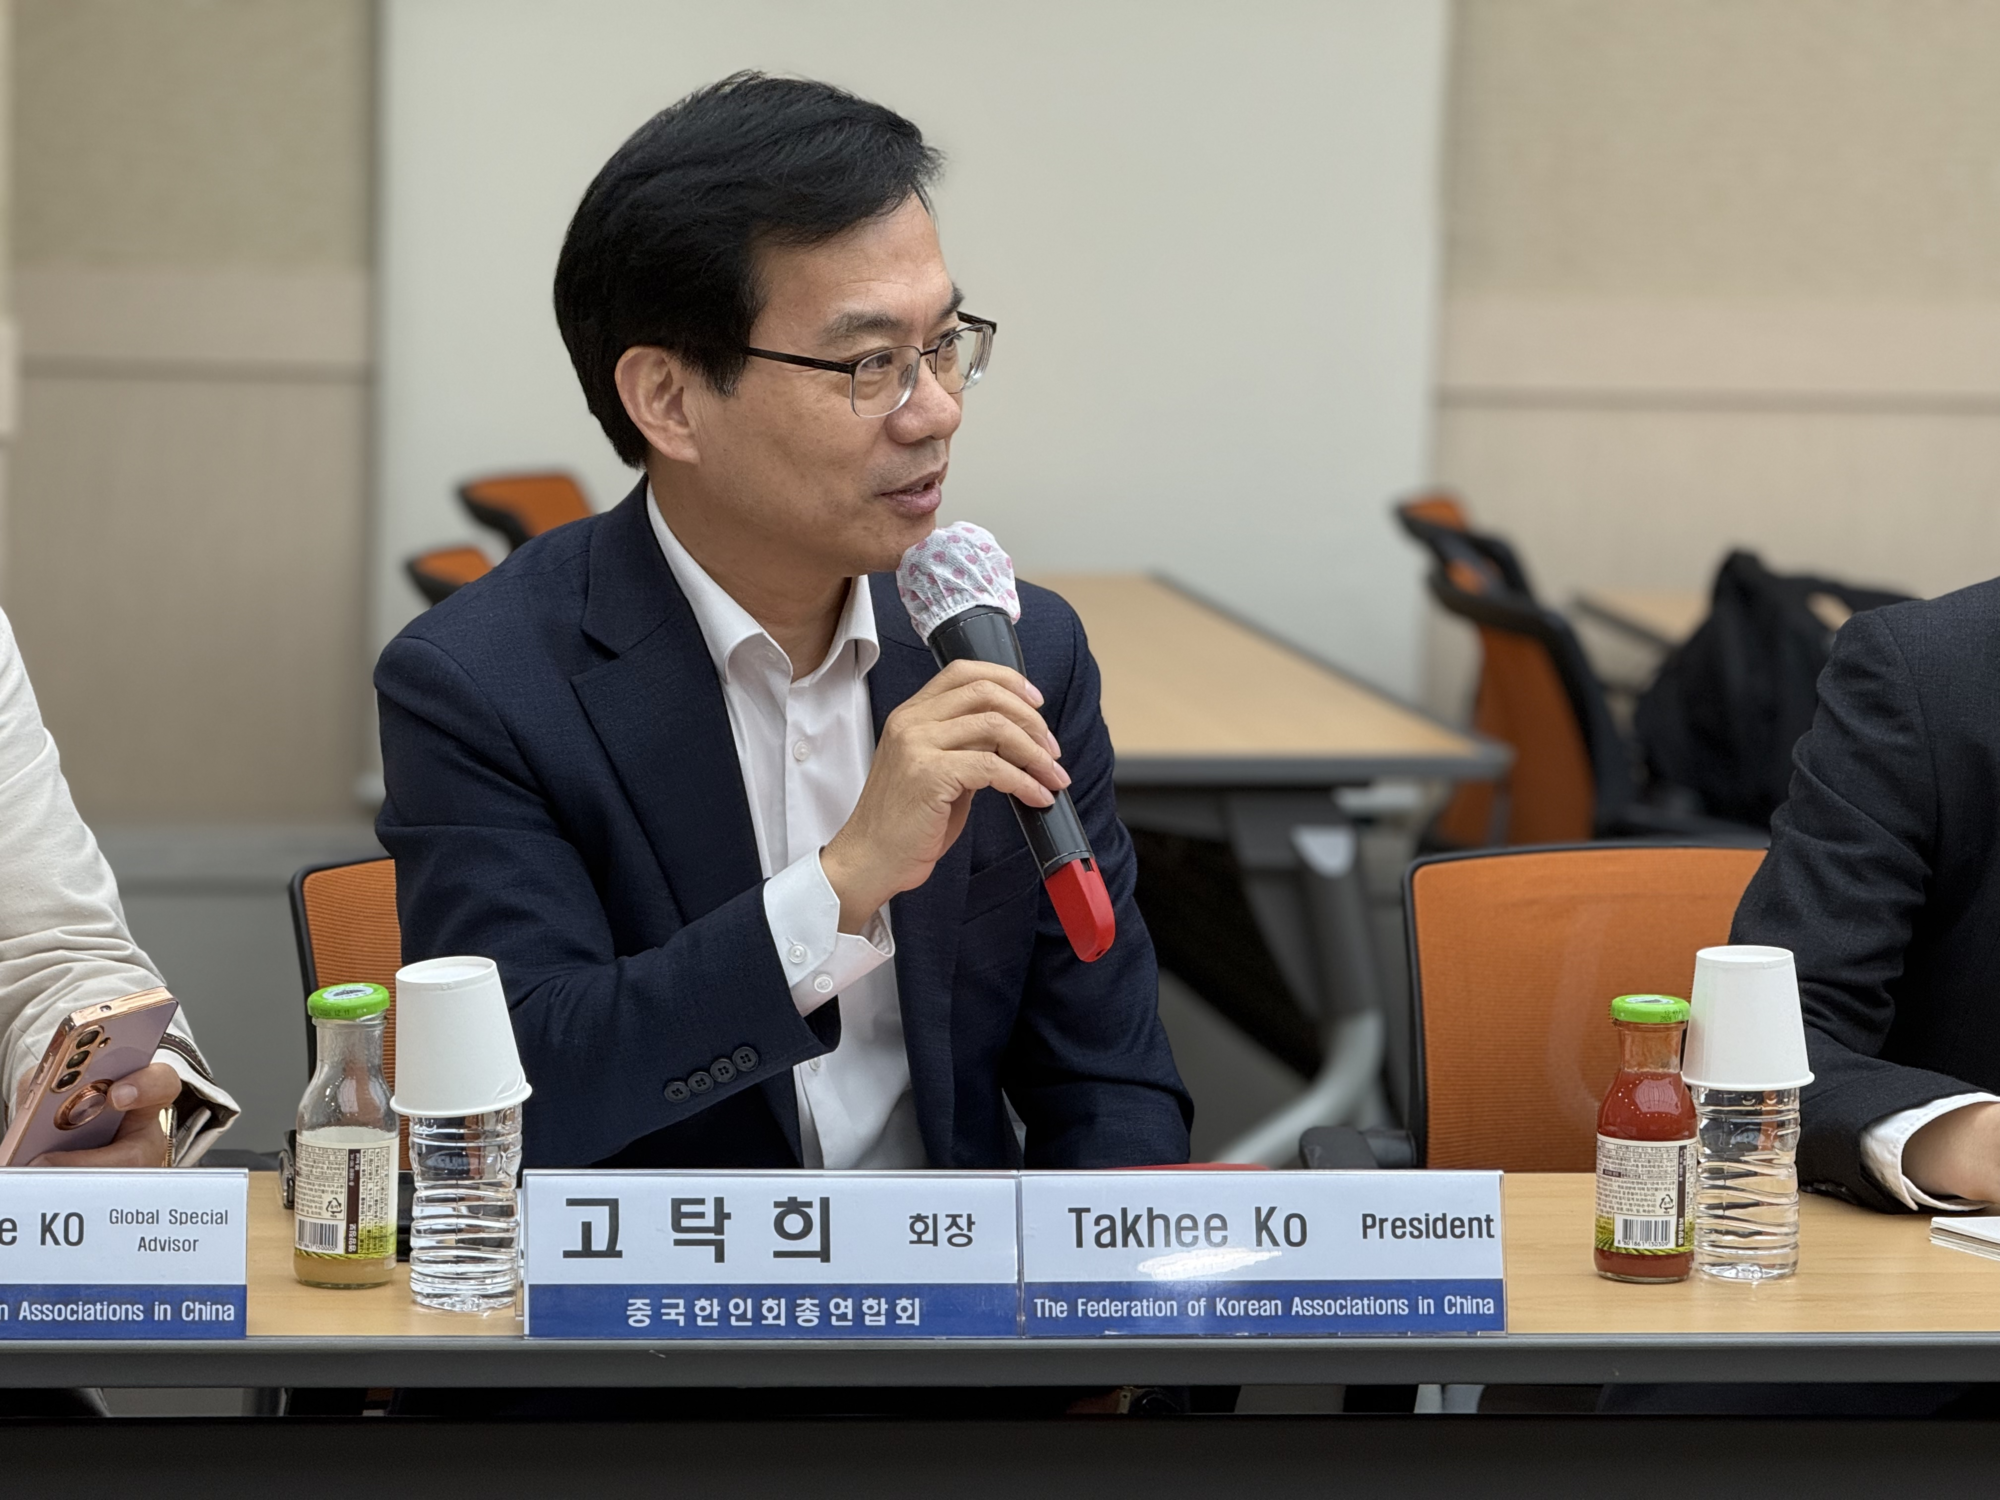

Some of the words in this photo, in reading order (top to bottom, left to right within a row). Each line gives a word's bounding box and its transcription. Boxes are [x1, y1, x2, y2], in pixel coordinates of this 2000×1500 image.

[40, 1211, 84, 1247] KO
[109, 1208, 160, 1225] Global
[168, 1208, 229, 1226] Special
[1067, 1206, 1229, 1249] Takhee
[1254, 1206, 1308, 1248] Ko
[1362, 1212, 1495, 1240] President
[137, 1235, 200, 1252] Advisor
[908, 1213, 976, 1248] 회장
[18, 1301, 144, 1321] Associations
[154, 1301, 171, 1321] in
[181, 1301, 235, 1321] China
[626, 1297, 921, 1327] 중국한인회총연합회
[1033, 1298, 1068, 1318] The
[1077, 1297, 1177, 1317] Federation
[1187, 1297, 1206, 1316] of
[1216, 1297, 1282, 1316] Korean
[1291, 1296, 1409, 1316] Associations
[1418, 1296, 1435, 1315] in
[1444, 1295, 1494, 1315] China
